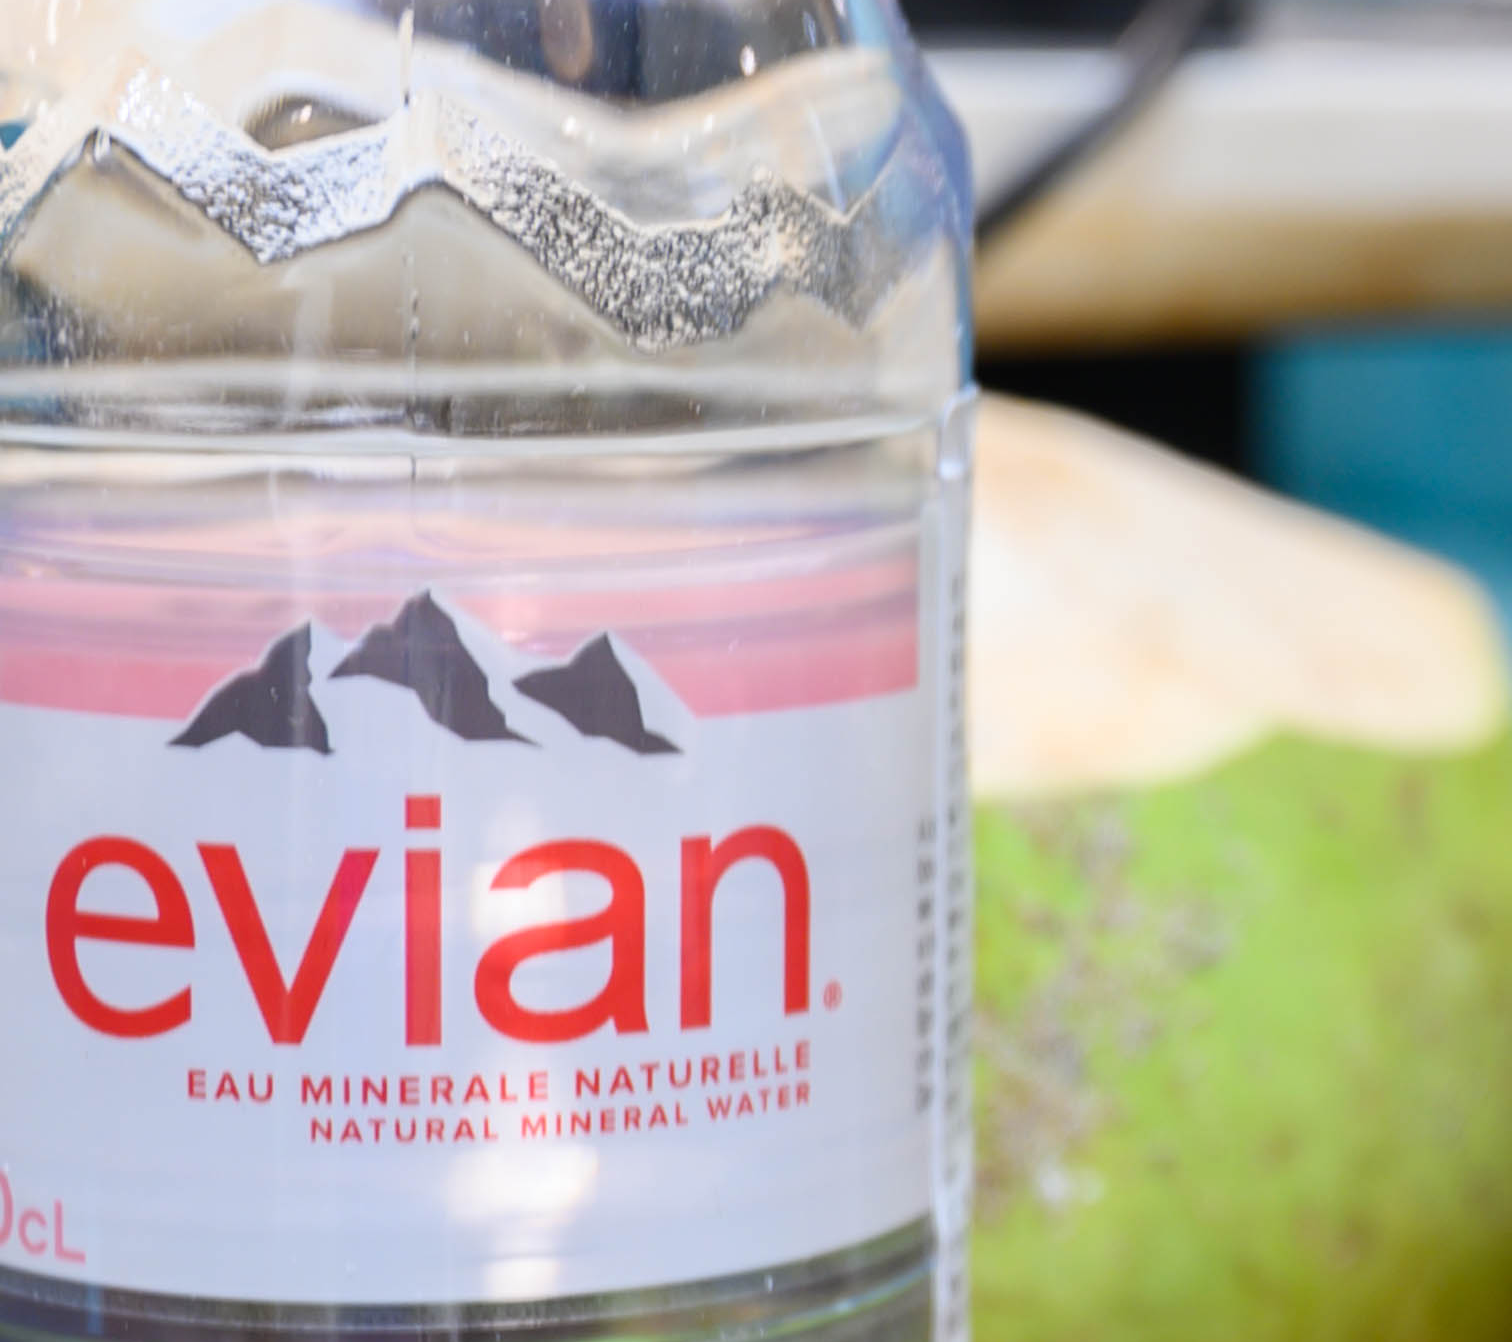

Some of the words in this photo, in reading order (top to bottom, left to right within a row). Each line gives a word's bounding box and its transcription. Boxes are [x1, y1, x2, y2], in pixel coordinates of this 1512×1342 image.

[186, 1067, 274, 1103] EAU
[300, 1070, 550, 1107] MINERALE
[575, 1039, 811, 1099] NATURELLE
[310, 1114, 499, 1144] NATURAL
[520, 1101, 689, 1139] MINERAL
[706, 1080, 811, 1123] WATER
